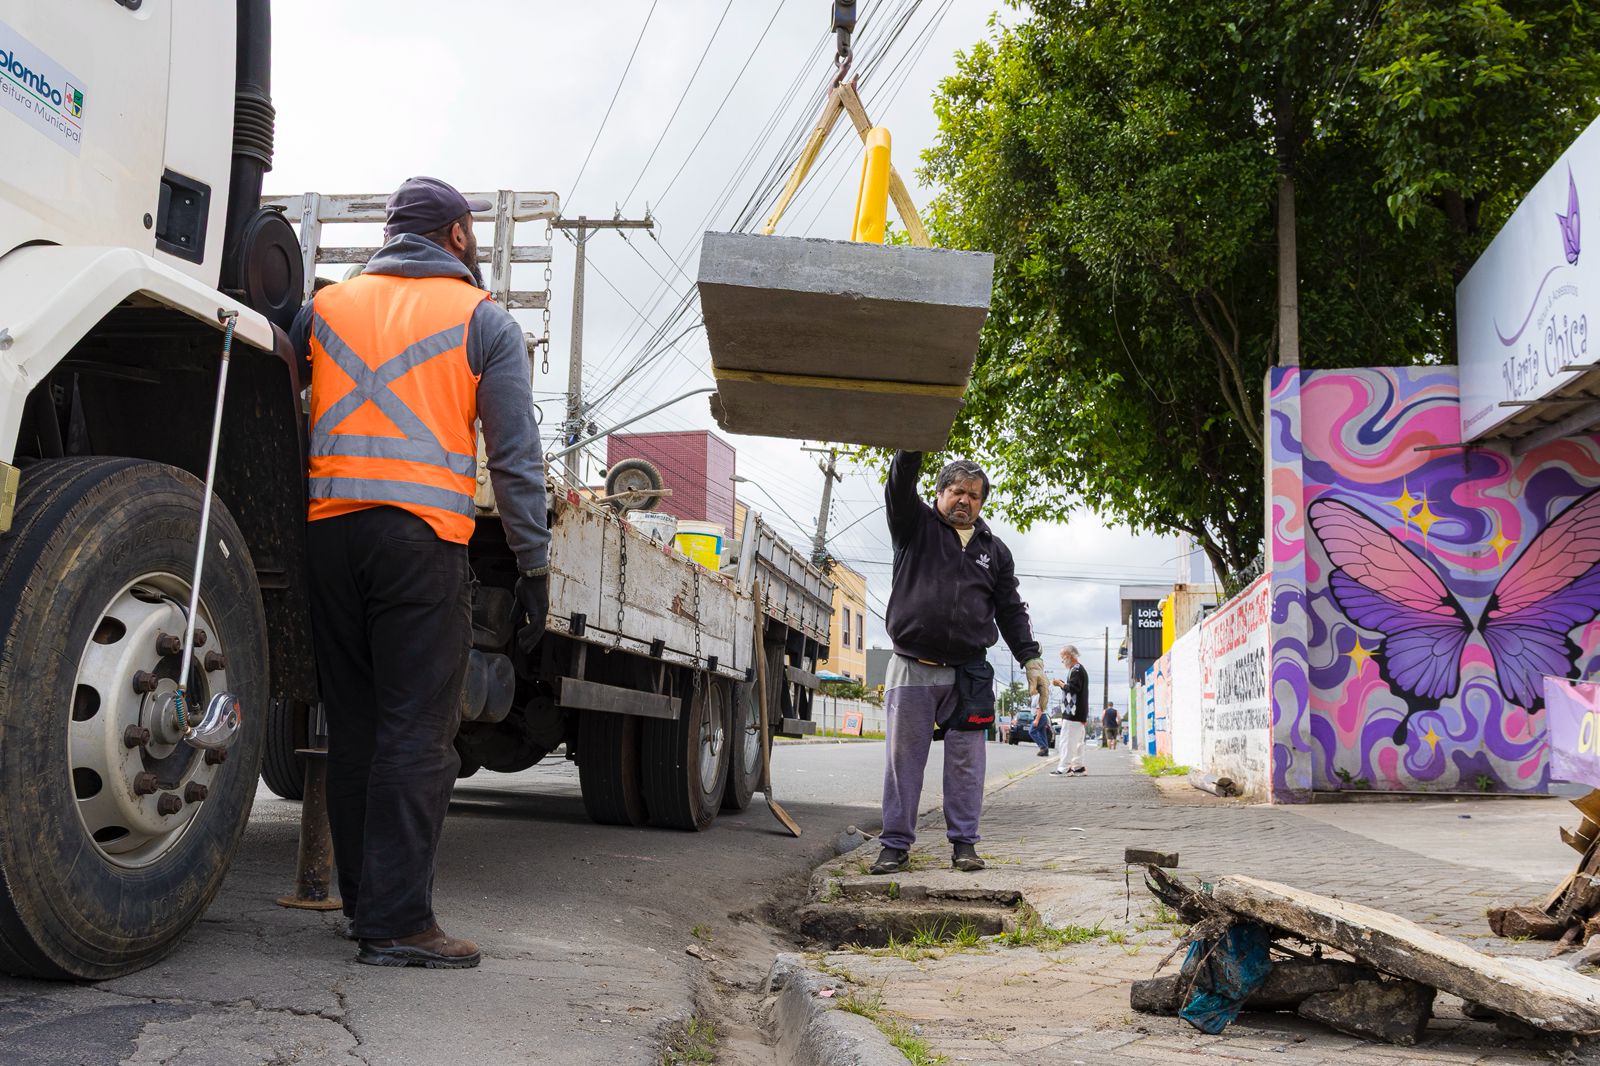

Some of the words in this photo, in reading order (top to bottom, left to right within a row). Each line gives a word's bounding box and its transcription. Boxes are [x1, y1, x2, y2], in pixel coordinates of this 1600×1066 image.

[34, 103, 82, 144] Municipal
[1503, 344, 1539, 400] Maria
[1544, 313, 1587, 378] Chica
[1138, 608, 1158, 619] Loja
